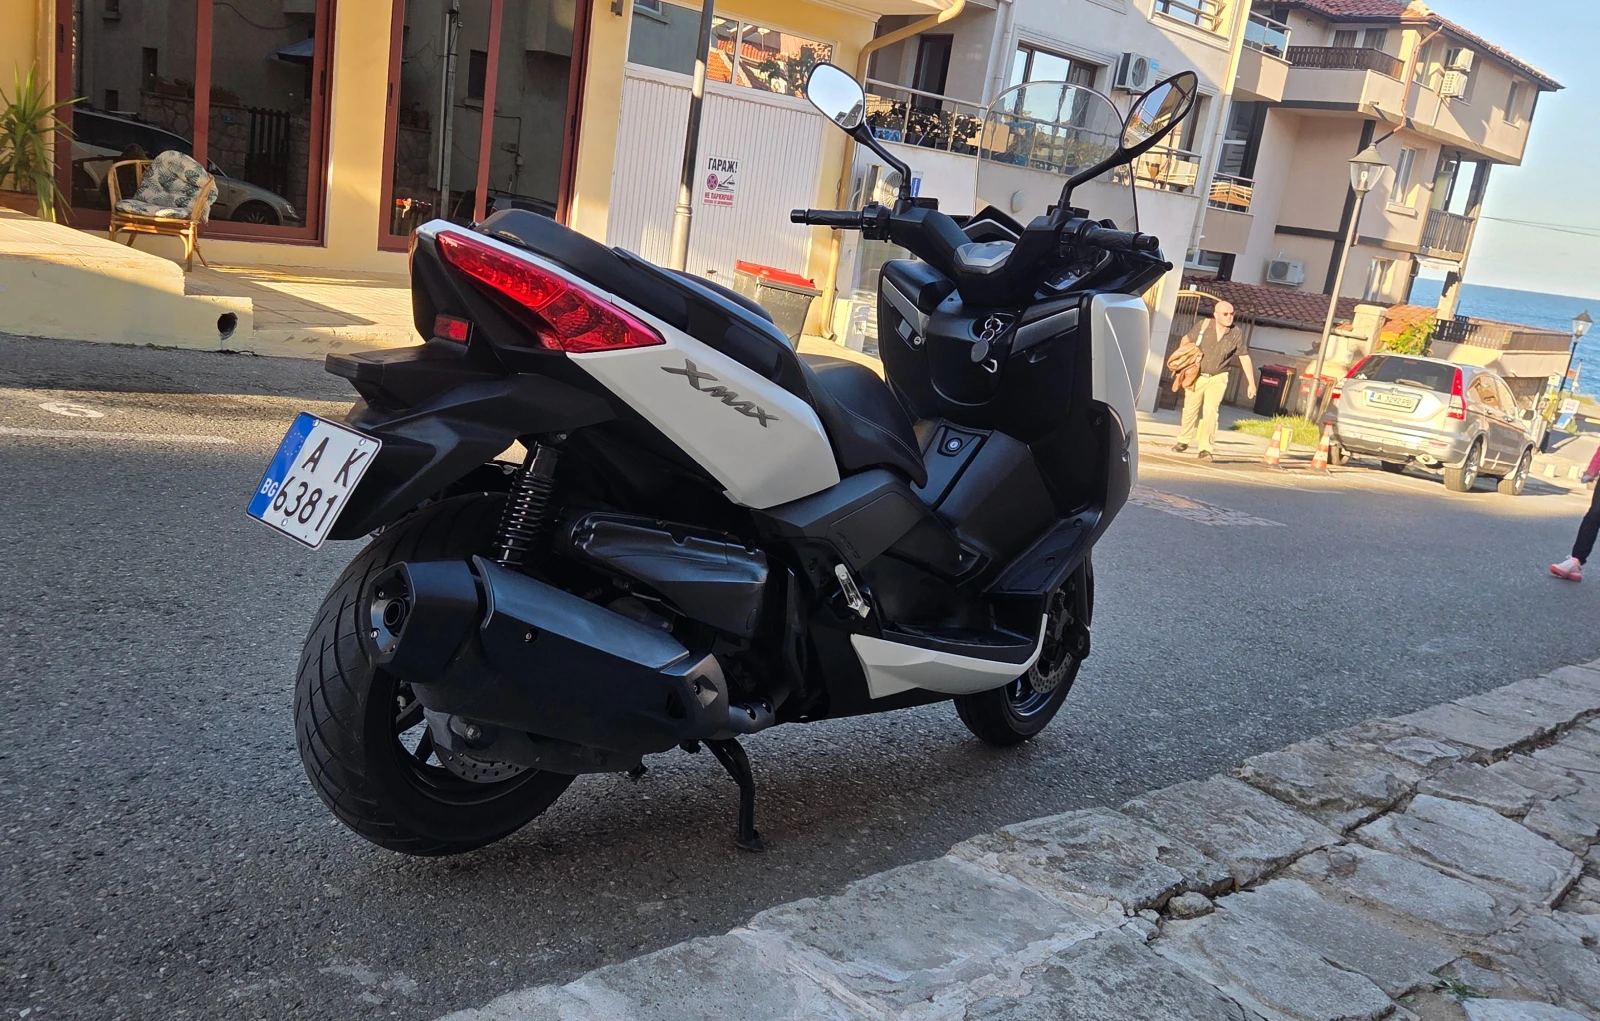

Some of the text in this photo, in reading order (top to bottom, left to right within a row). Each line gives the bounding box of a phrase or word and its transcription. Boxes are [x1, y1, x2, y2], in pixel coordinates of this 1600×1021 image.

[708, 158, 738, 173] ГАРАЖ!
[660, 358, 779, 428] XMAX
[260, 477, 279, 498] BG
[301, 437, 369, 488] A K
[272, 476, 339, 532] 6381
